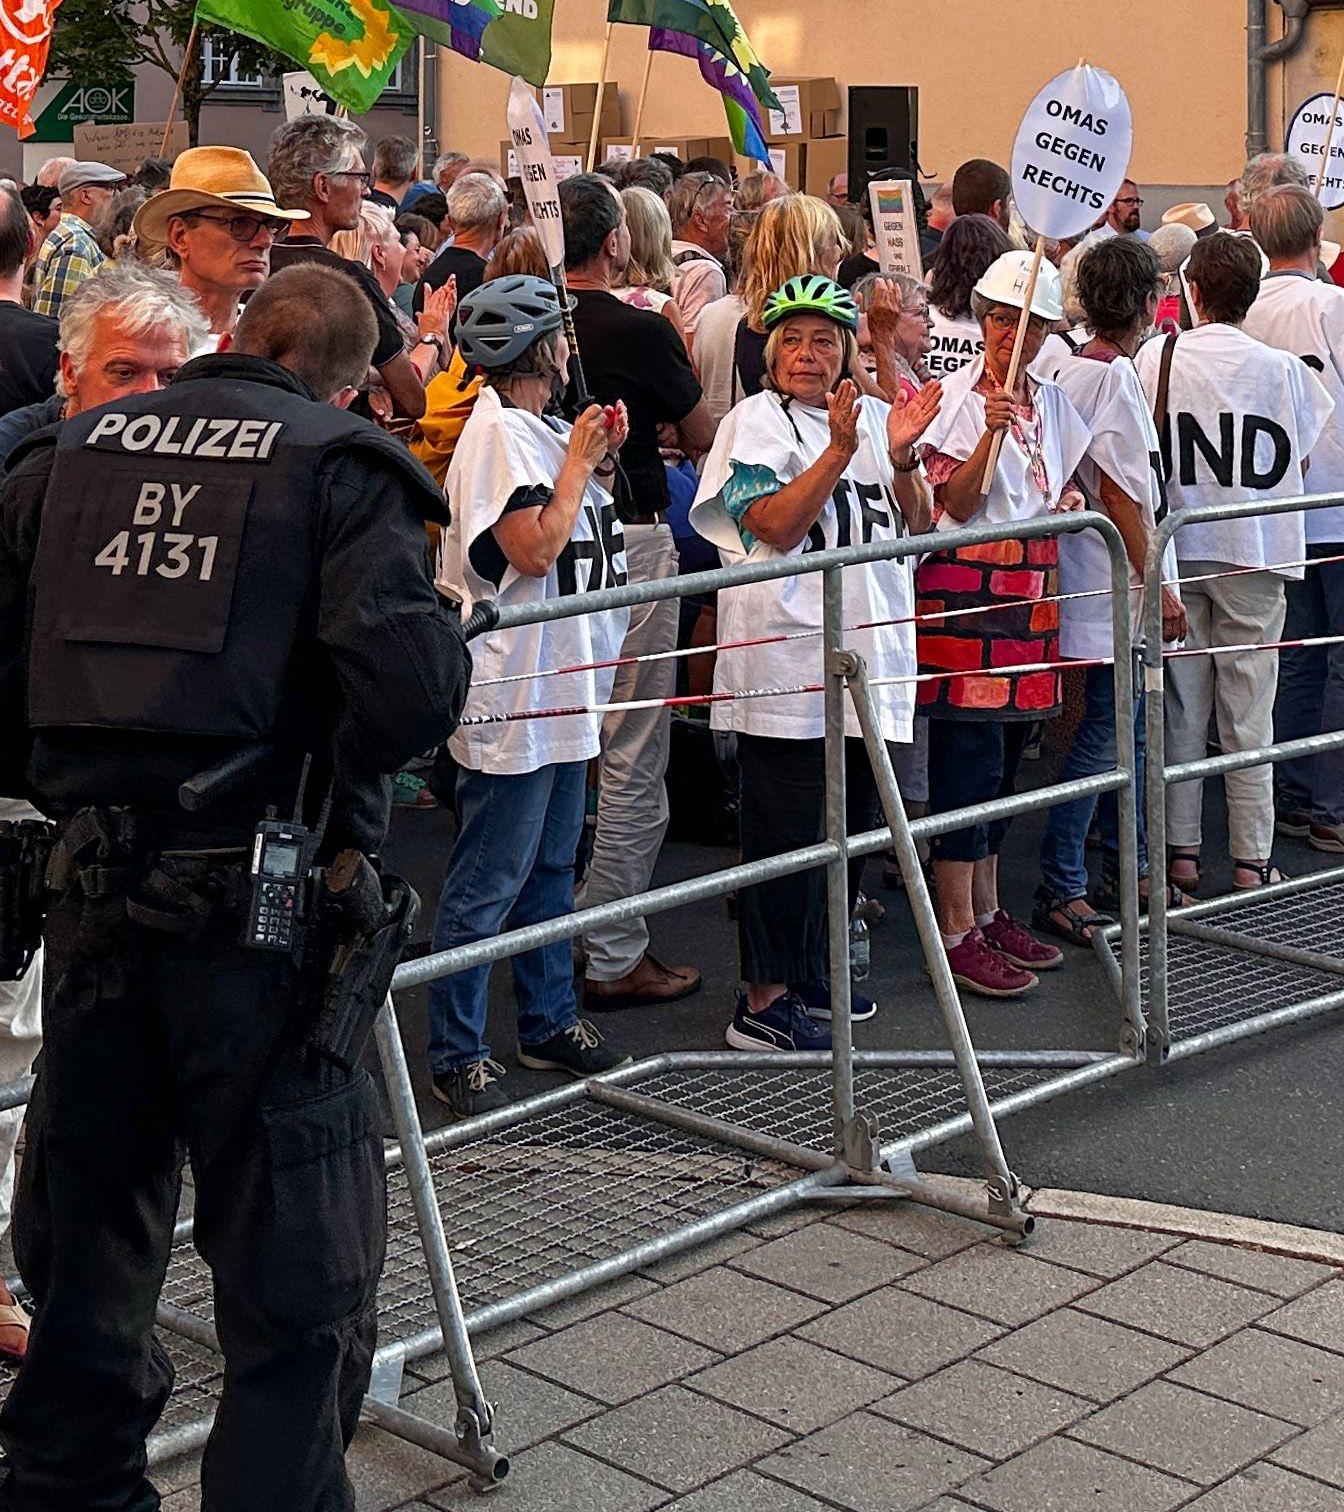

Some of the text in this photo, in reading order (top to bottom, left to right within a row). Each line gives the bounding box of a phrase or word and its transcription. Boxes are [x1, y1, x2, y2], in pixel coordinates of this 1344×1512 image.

[61, 88, 129, 113] AOK
[1046, 99, 1109, 136] OMAS
[1035, 131, 1106, 172] GEGEN
[1022, 164, 1105, 209] RECHTS
[85, 413, 283, 459] POLIZEI
[133, 482, 202, 527] BY
[94, 530, 218, 581] 4131
